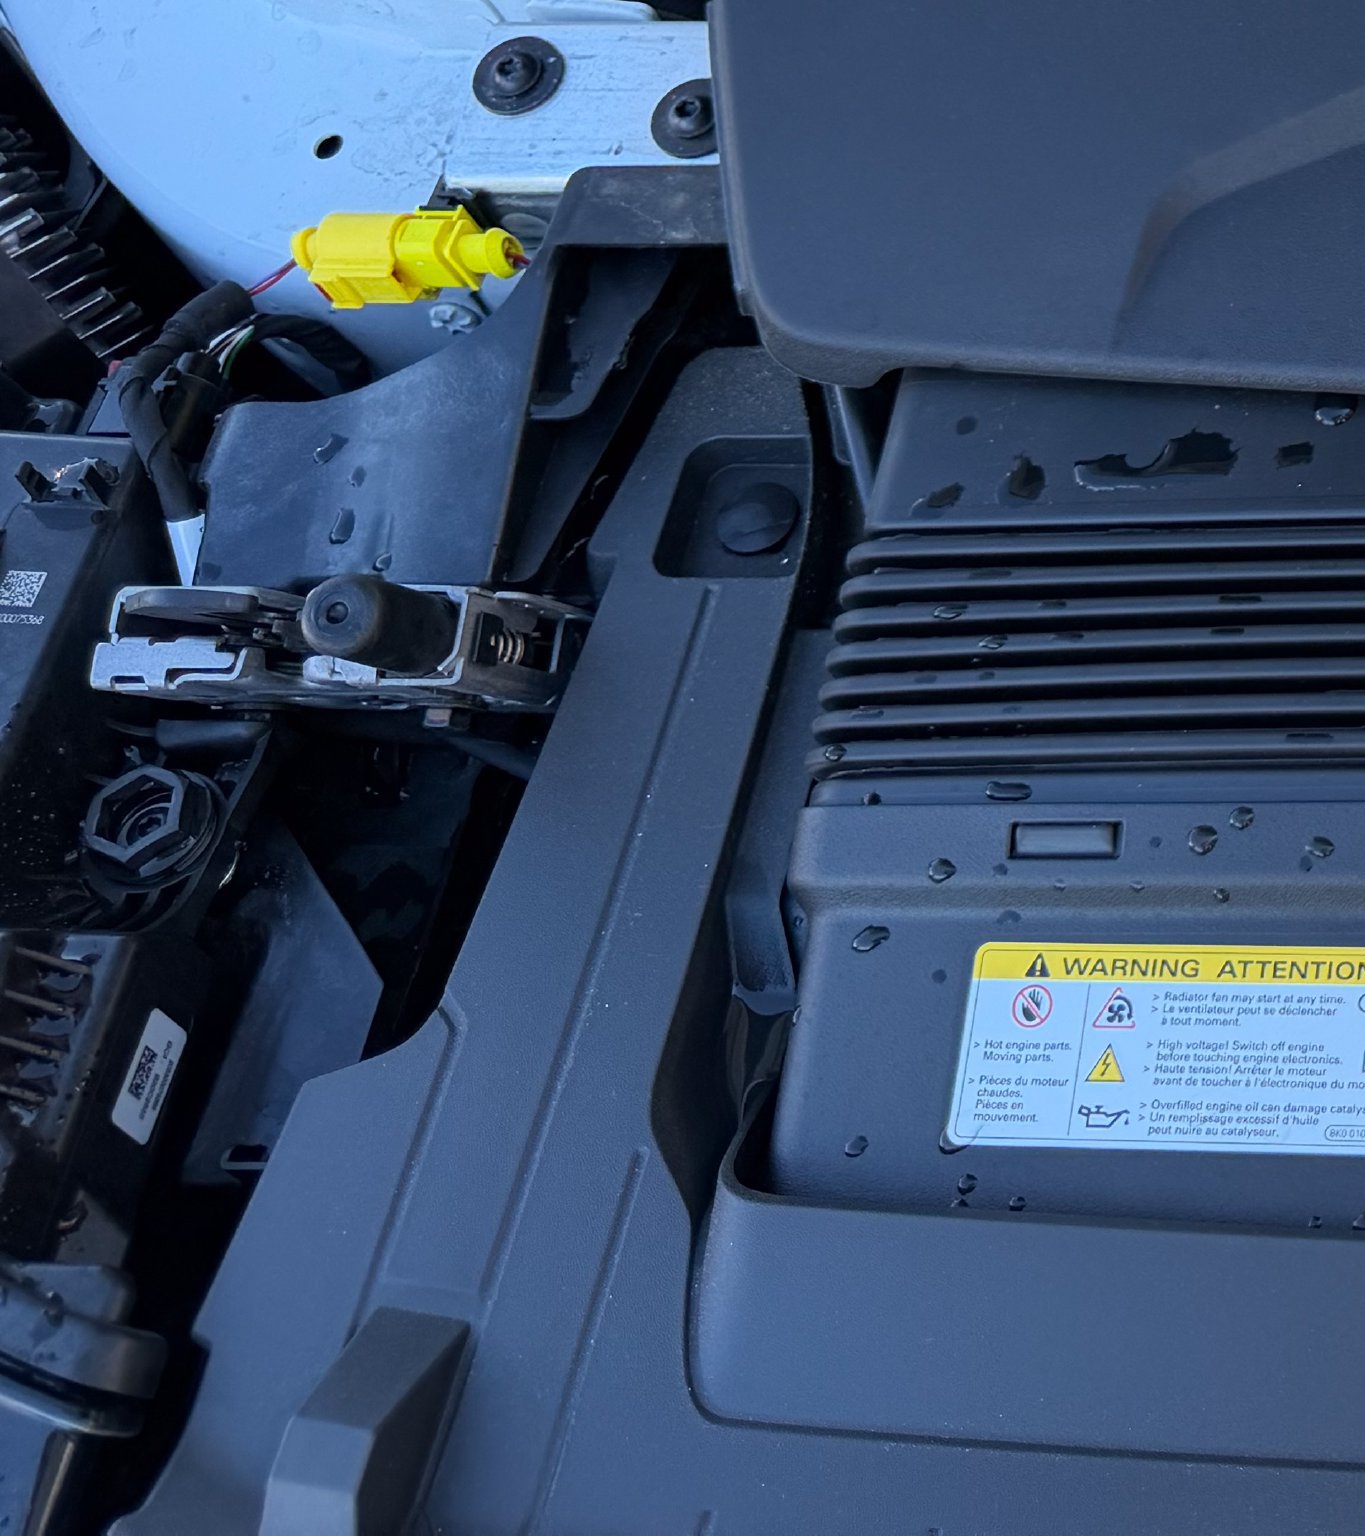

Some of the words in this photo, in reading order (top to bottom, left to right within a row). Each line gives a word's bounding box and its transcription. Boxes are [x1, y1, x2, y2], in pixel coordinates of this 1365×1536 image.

[1063, 957, 1200, 978] WARNING
[1164, 991, 1208, 1002] Radiator
[1211, 992, 1228, 1003] fan
[1231, 995, 1254, 1005] may
[1257, 994, 1281, 1003] start
[1284, 995, 1293, 1003] at
[1297, 996, 1317, 1005] any
[1320, 995, 1346, 1004] time.
[1162, 1004, 1175, 1013] Le
[1178, 1004, 1234, 1015] ventilateur
[1237, 1006, 1261, 1016] peut
[1279, 1006, 1337, 1016] déclencher
[1170, 1018, 1192, 1026] tout
[1194, 1018, 1241, 1027] moment.
[984, 1040, 1003, 1049] Hot
[1005, 1041, 1040, 1051] engine
[1043, 1042, 1072, 1051] parts.
[1158, 1040, 1182, 1054] High
[1186, 1041, 1229, 1051] voltage!
[1232, 1041, 1268, 1051] Switch
[1271, 1042, 1286, 1051] off
[1288, 1043, 1324, 1053] engine
[983, 1051, 1022, 1063] Moving
[1025, 1053, 1054, 1064] parts.
[1157, 1052, 1190, 1061] before
[1194, 1053, 1240, 1064] touching
[1243, 1055, 1279, 1065] engine
[1282, 1055, 1343, 1064] electronics.
[1154, 1064, 1185, 1074] Haute
[1189, 1065, 1232, 1075] tension!
[1235, 1065, 1271, 1075] Arrêter
[1275, 1067, 1284, 1075] le
[1288, 1068, 1326, 1076] moteur
[979, 1075, 1011, 1085] Pièces
[1015, 1076, 1028, 1086] du
[1031, 1078, 1069, 1086] moteur
[1153, 1077, 1182, 1086] avant
[1185, 1077, 1198, 1086] de
[1202, 1078, 1242, 1087] toucher
[1245, 1078, 1251, 1087] à
[1254, 1079, 1327, 1090] l'électronique
[1331, 1080, 1345, 1089] du
[977, 1088, 1023, 1097] chaudes.
[976, 1099, 1008, 1109] Pièces
[1011, 1102, 1023, 1110] en
[1152, 1099, 1202, 1111] Overfilled
[1205, 1102, 1242, 1113] engine
[1245, 1102, 1259, 1112] oil
[1261, 1104, 1281, 1112] can
[1284, 1103, 1327, 1115] damage
[973, 1113, 1038, 1122] mouvement.
[1149, 1112, 1166, 1122] Un
[1168, 1113, 1234, 1126] remplissage
[1236, 1115, 1280, 1124] excessif
[1282, 1115, 1319, 1125] d'huile
[1148, 1126, 1171, 1137] peut
[1174, 1126, 1202, 1136] nuire
[1205, 1127, 1218, 1136] au
[1221, 1127, 1279, 1138] catalyseur.
[1349, 1129, 1365, 1138] 010
